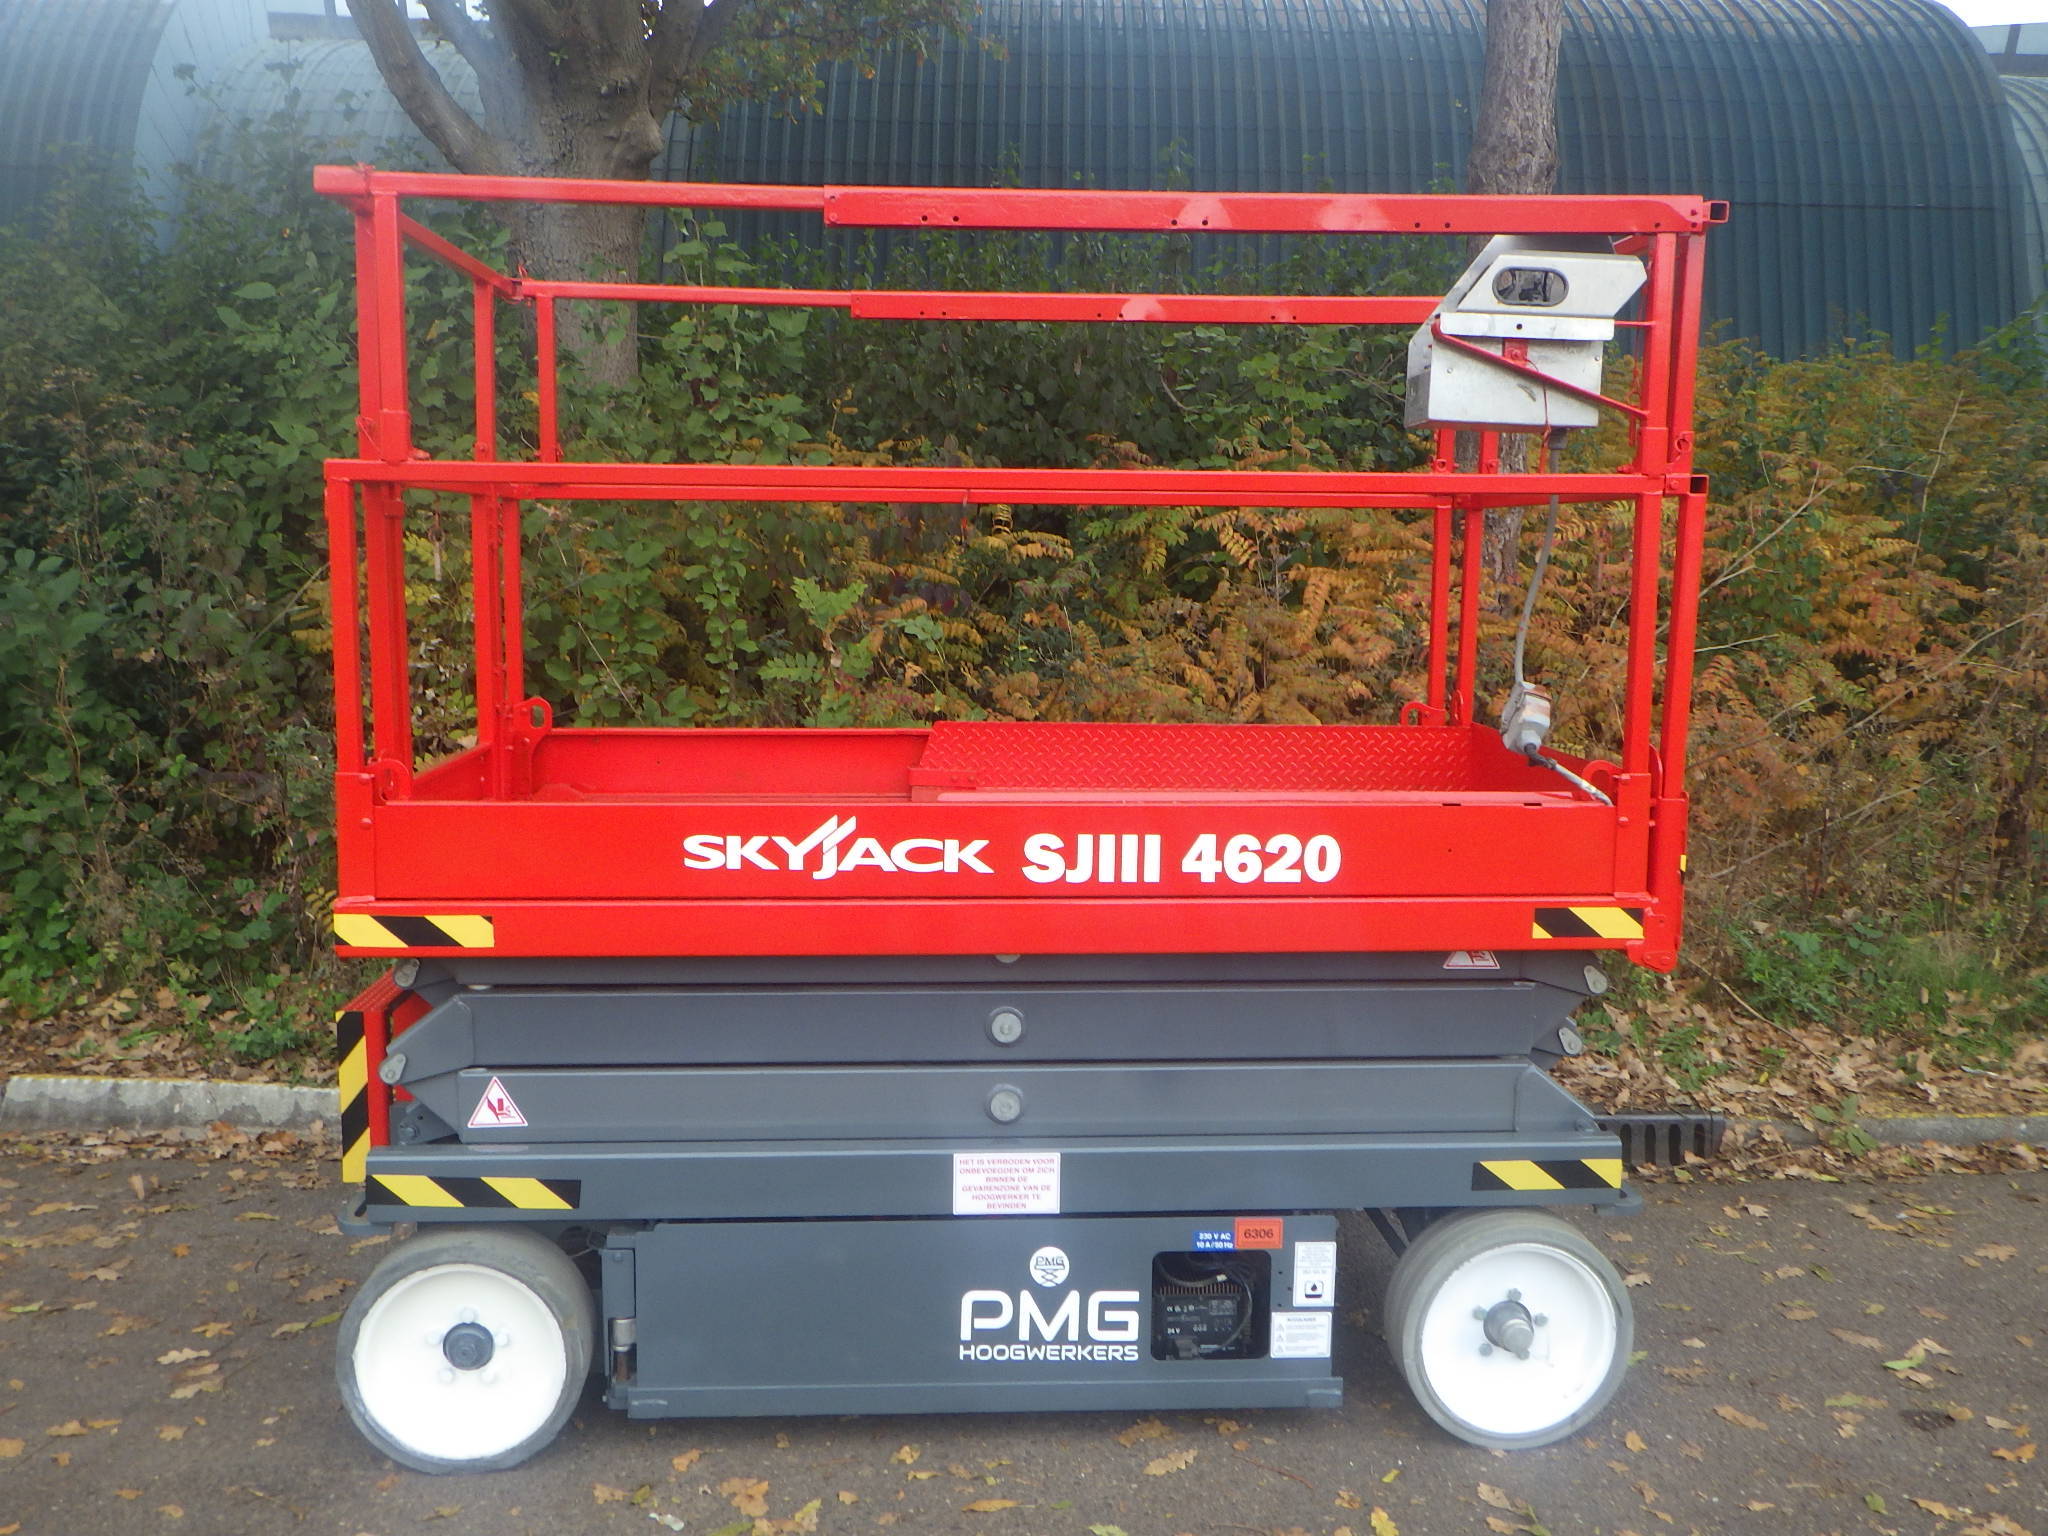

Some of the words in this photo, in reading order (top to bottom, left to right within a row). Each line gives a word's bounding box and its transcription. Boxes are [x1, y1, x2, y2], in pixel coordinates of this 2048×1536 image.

[683, 814, 994, 880] SKYJACK
[1021, 833, 1161, 884] SJIII
[1181, 833, 1342, 884] 4620
[1220, 1232, 1232, 1240] AC
[1243, 1228, 1274, 1240] 6306
[1036, 1256, 1065, 1267] PMG
[960, 1289, 1140, 1342] PMG
[959, 1344, 1139, 1361] HOOGWERKERS
